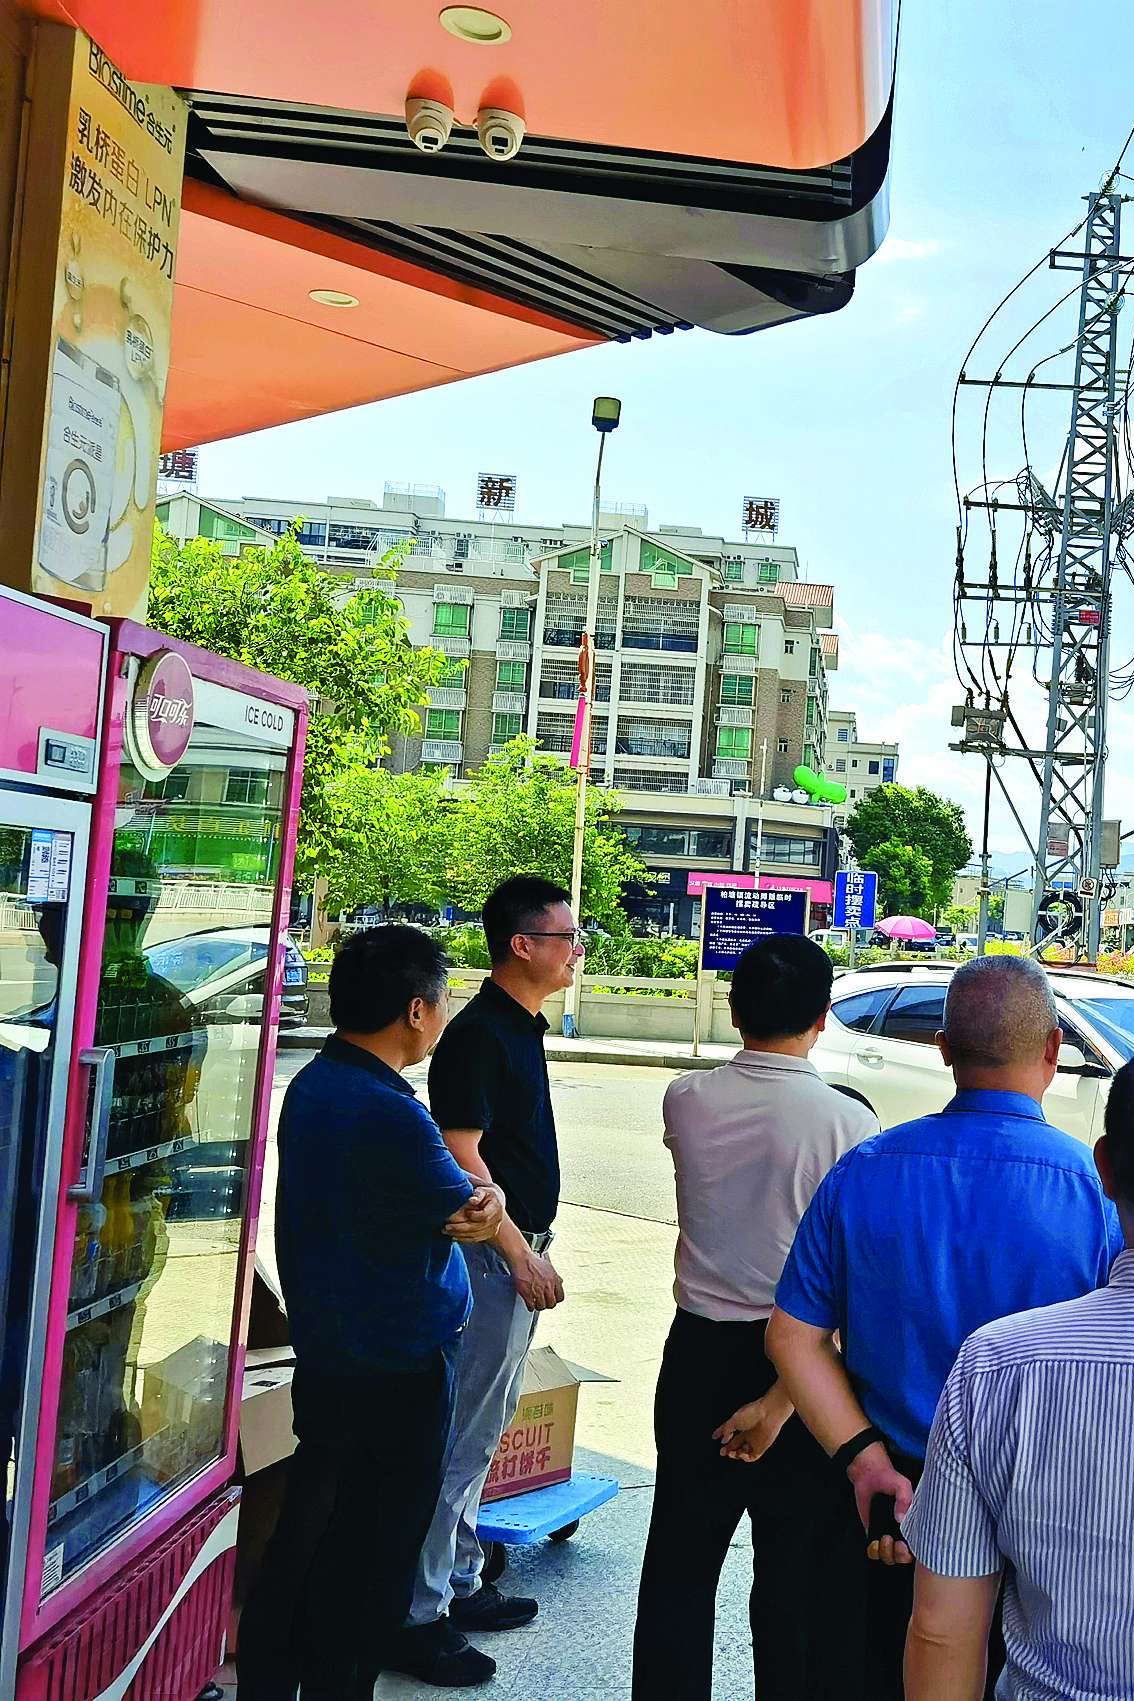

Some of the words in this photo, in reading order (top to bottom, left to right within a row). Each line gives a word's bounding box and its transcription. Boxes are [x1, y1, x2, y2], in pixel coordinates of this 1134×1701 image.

[146, 111, 173, 154] 合生元
[78, 105, 140, 198] 乳桥蛋白
[144, 177, 172, 228] LPN
[69, 149, 174, 280] 激发内在保护力
[150, 693, 193, 726] 可口可乐
[244, 704, 260, 725] ICE
[260, 710, 284, 732] COLD
[844, 872, 865, 928] 临时摆卖点
[500, 1422, 554, 1454] SCUIT
